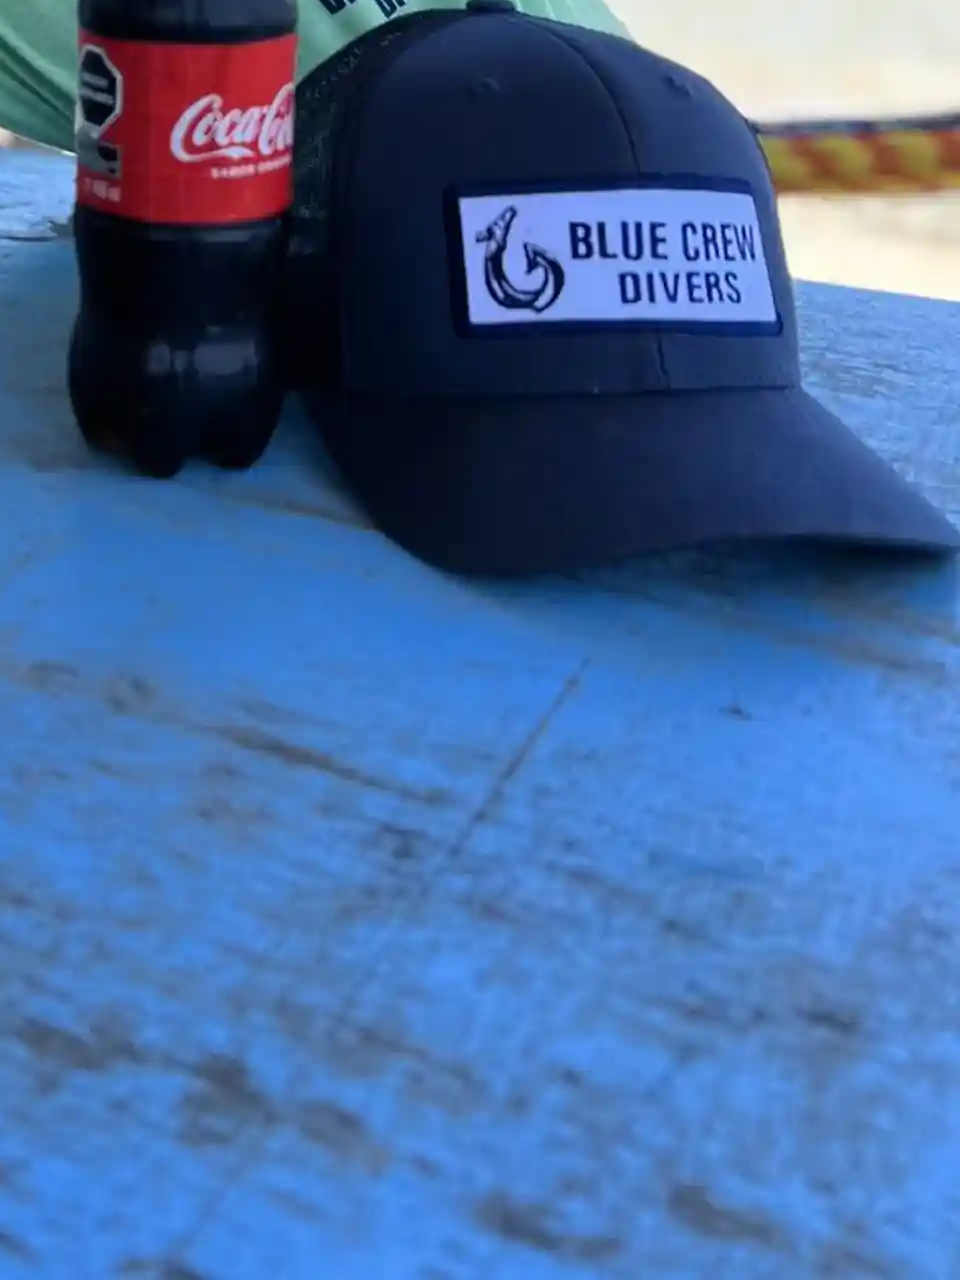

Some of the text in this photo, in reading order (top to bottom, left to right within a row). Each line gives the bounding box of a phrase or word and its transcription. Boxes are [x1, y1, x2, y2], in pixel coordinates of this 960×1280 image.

[569, 221, 758, 262] BLUE CREW
[618, 271, 742, 304] DIVERS
